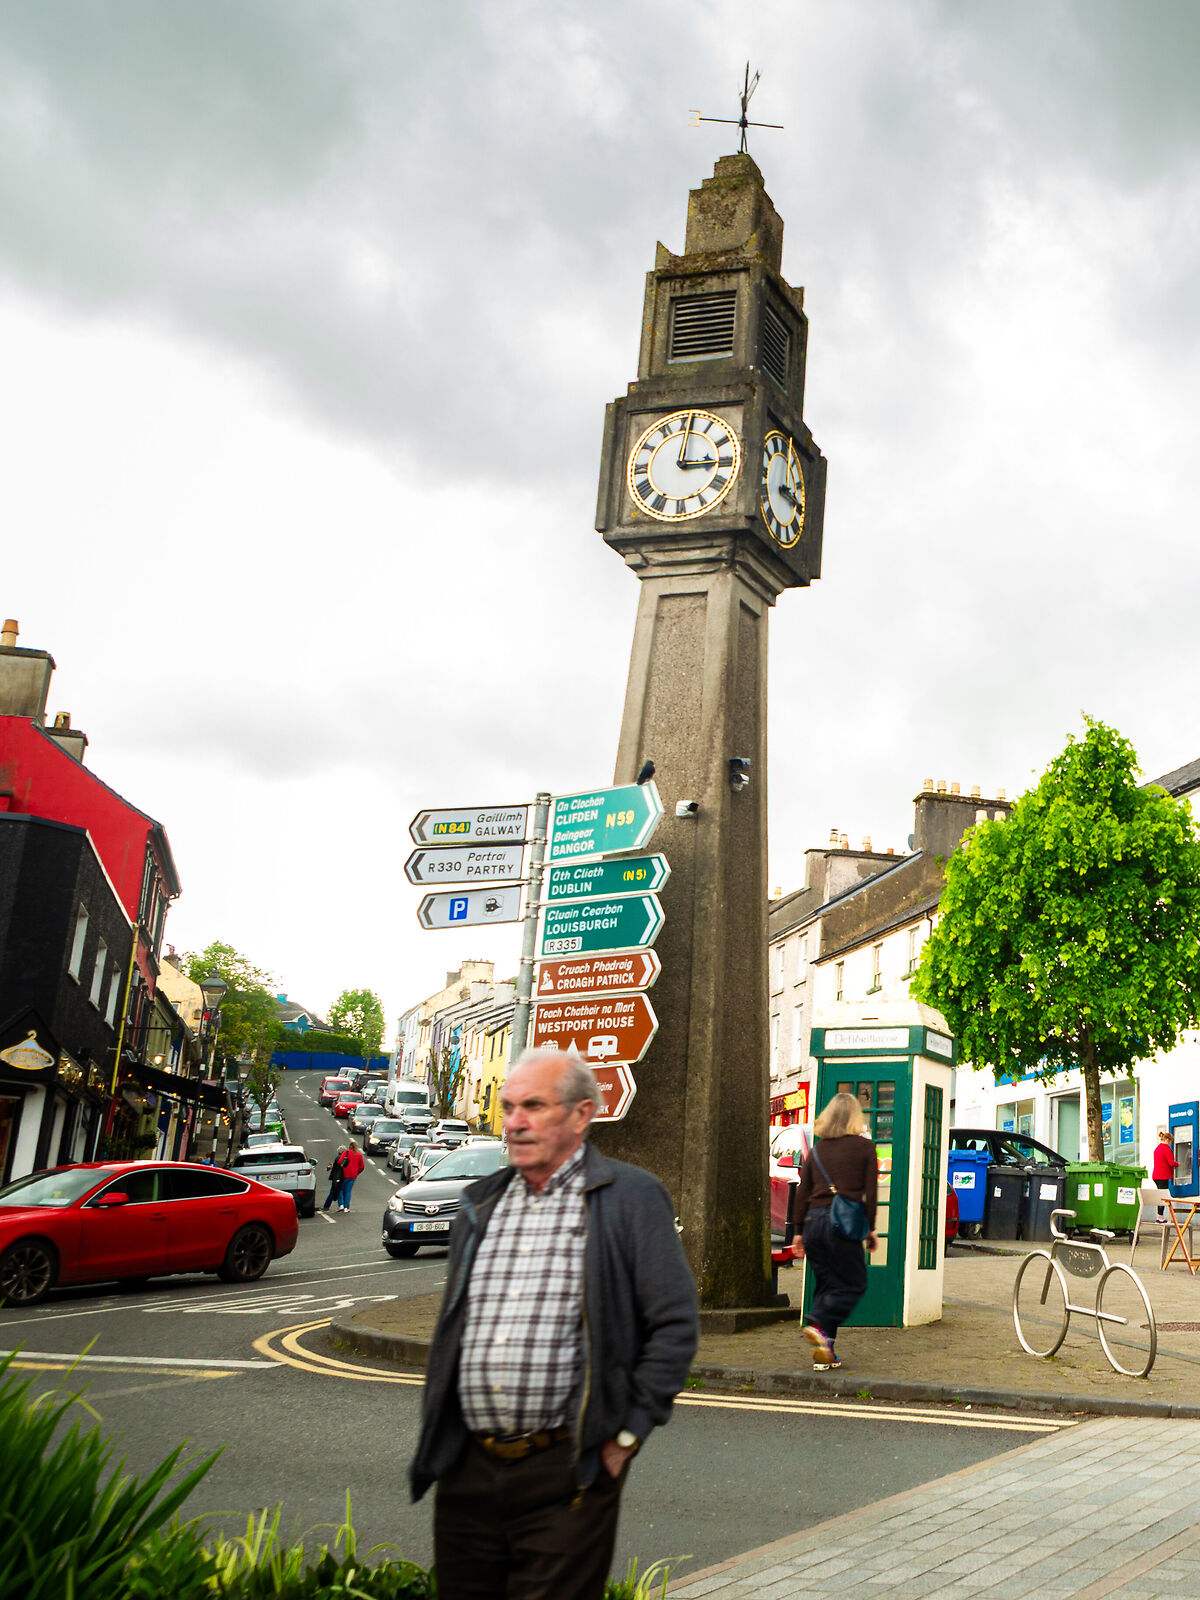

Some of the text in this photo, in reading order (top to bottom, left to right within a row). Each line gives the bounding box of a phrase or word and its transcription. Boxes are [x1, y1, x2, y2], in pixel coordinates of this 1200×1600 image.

[476, 811, 523, 824] Gaillimh
[556, 809, 598, 826] CLIFDEN
[475, 825, 522, 837] GALWAY
[552, 840, 595, 856] BANGOR
[466, 864, 515, 876] PARTRY
[573, 867, 604, 879] Cliath
[552, 882, 592, 895] DUBLIN
[547, 908, 579, 921] Cluain
[546, 917, 618, 935] LOUISBURGH
[558, 962, 590, 976] Cruach
[557, 972, 635, 990] CROAGH PATRICK
[539, 1001, 636, 1019] Teach Chathair na Mart
[538, 1016, 635, 1034] WESTPORT HOUSE
